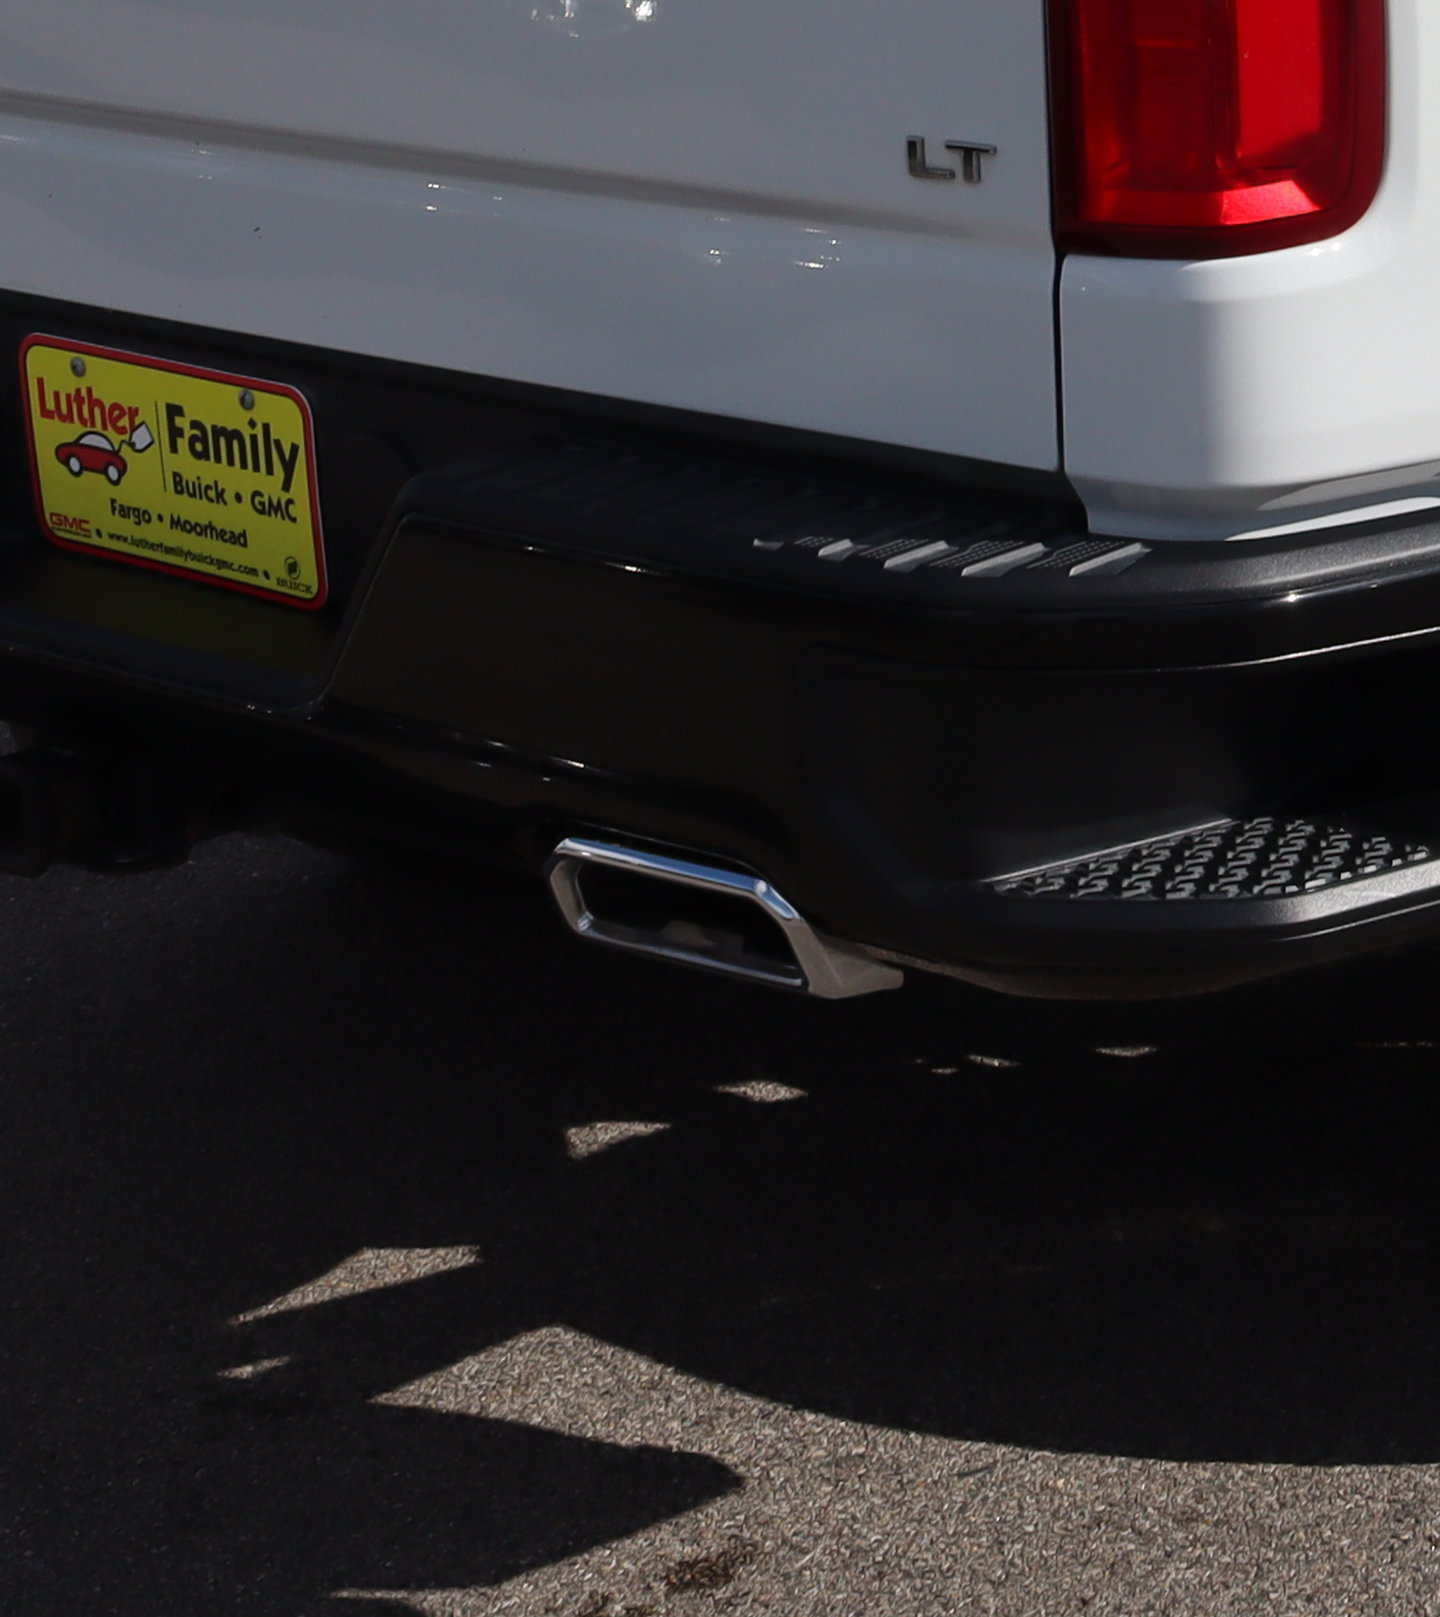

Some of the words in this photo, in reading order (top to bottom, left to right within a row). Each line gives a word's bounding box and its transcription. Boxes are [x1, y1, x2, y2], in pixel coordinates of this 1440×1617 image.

[906, 135, 997, 183] LT
[36, 377, 139, 435] Luther
[165, 402, 300, 494] Family
[50, 512, 91, 534] GMC
[110, 498, 153, 526] Fargo
[169, 513, 249, 548] Moorhead
[172, 472, 228, 507] Buick
[250, 490, 298, 524] GMC
